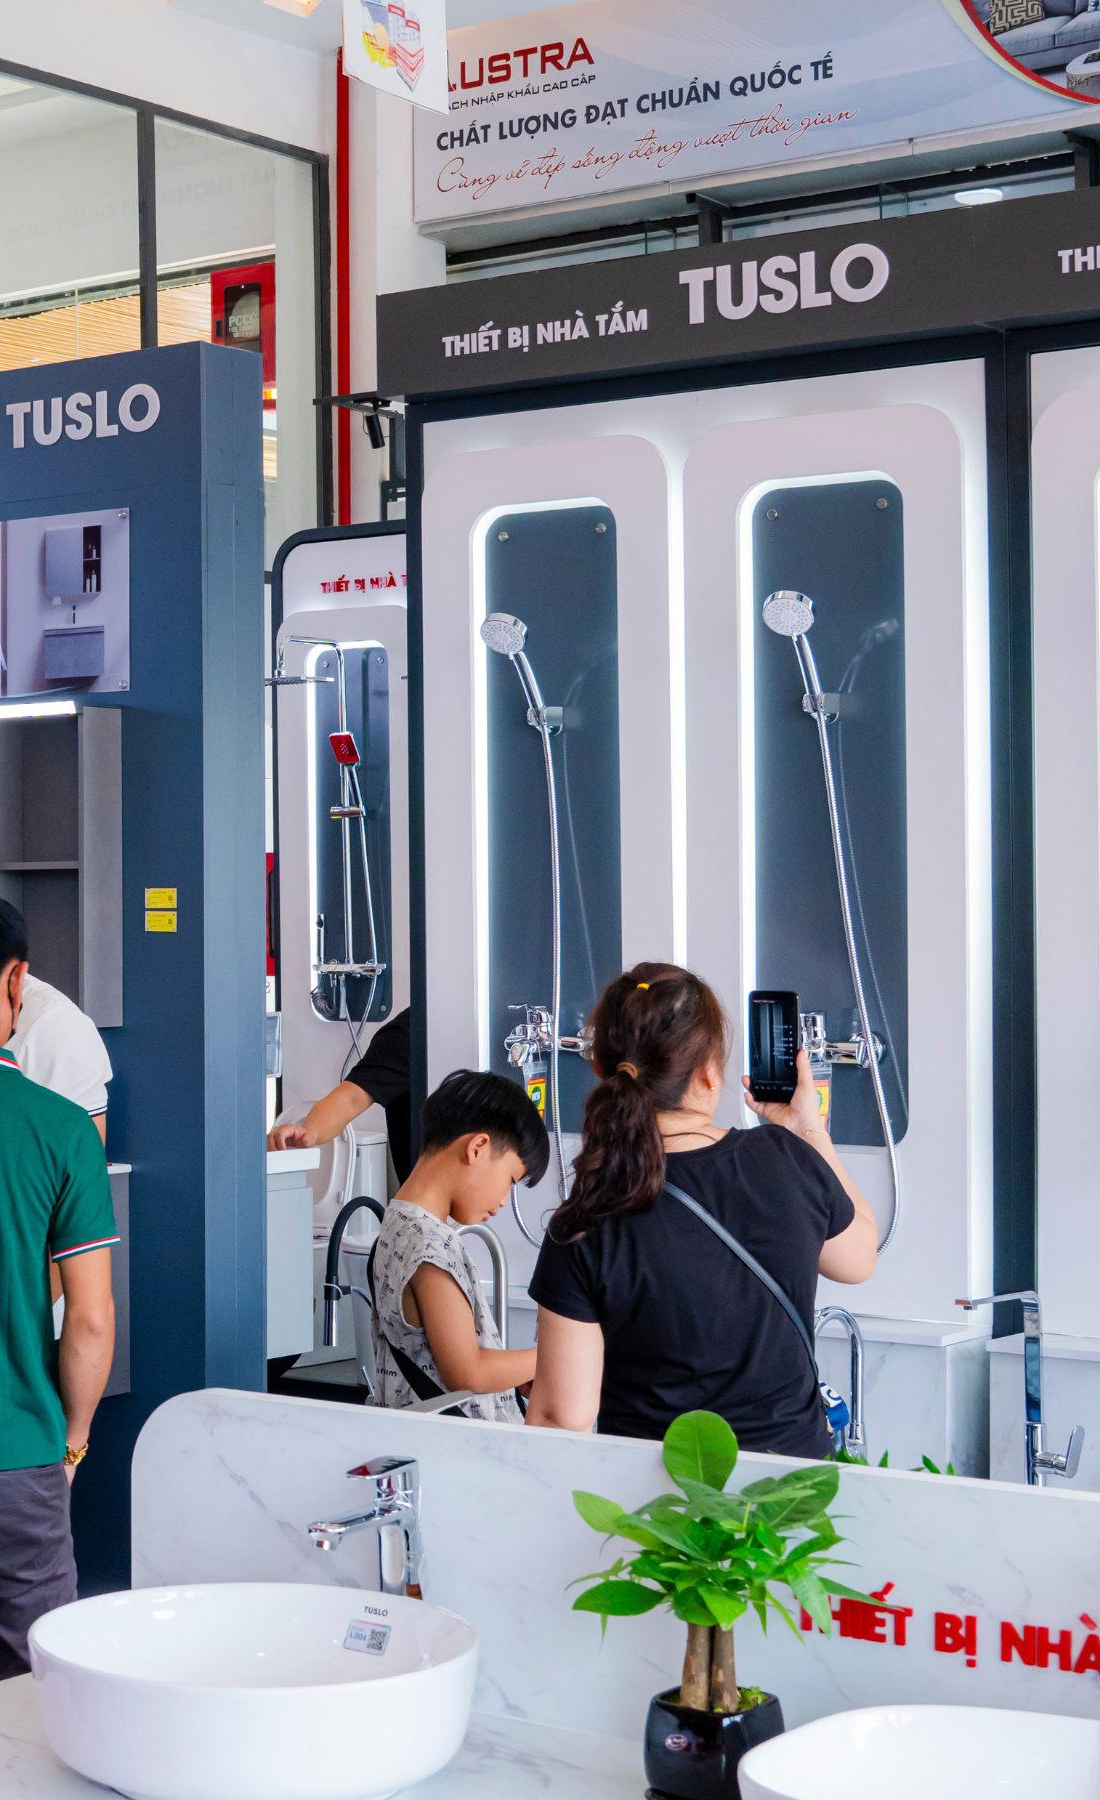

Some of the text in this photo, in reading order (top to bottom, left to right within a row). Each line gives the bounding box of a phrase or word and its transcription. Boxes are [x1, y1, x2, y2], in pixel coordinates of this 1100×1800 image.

[436, 50, 833, 151] CHẤT LƯỢNG ĐẠT CHUẨN QUỐC TẾ
[471, 92, 504, 106] NHẬP
[507, 83, 540, 98] KHẨU
[542, 80, 568, 93] CAO
[436, 156, 502, 200] Cùng
[531, 147, 566, 189] đẹp
[571, 146, 626, 180] sống
[628, 128, 690, 169] động
[784, 109, 859, 146] gian
[442, 243, 890, 358] THIẾT BỊ NHÀ TẮM TUSLO
[5, 383, 161, 450] TUSLO
[320, 574, 350, 593] THIẾT
[354, 579, 365, 593] BỊ
[370, 571, 397, 589] NHÀ
[364, 1605, 389, 1617] TUSLO
[934, 1611, 977, 1668] BỊ
